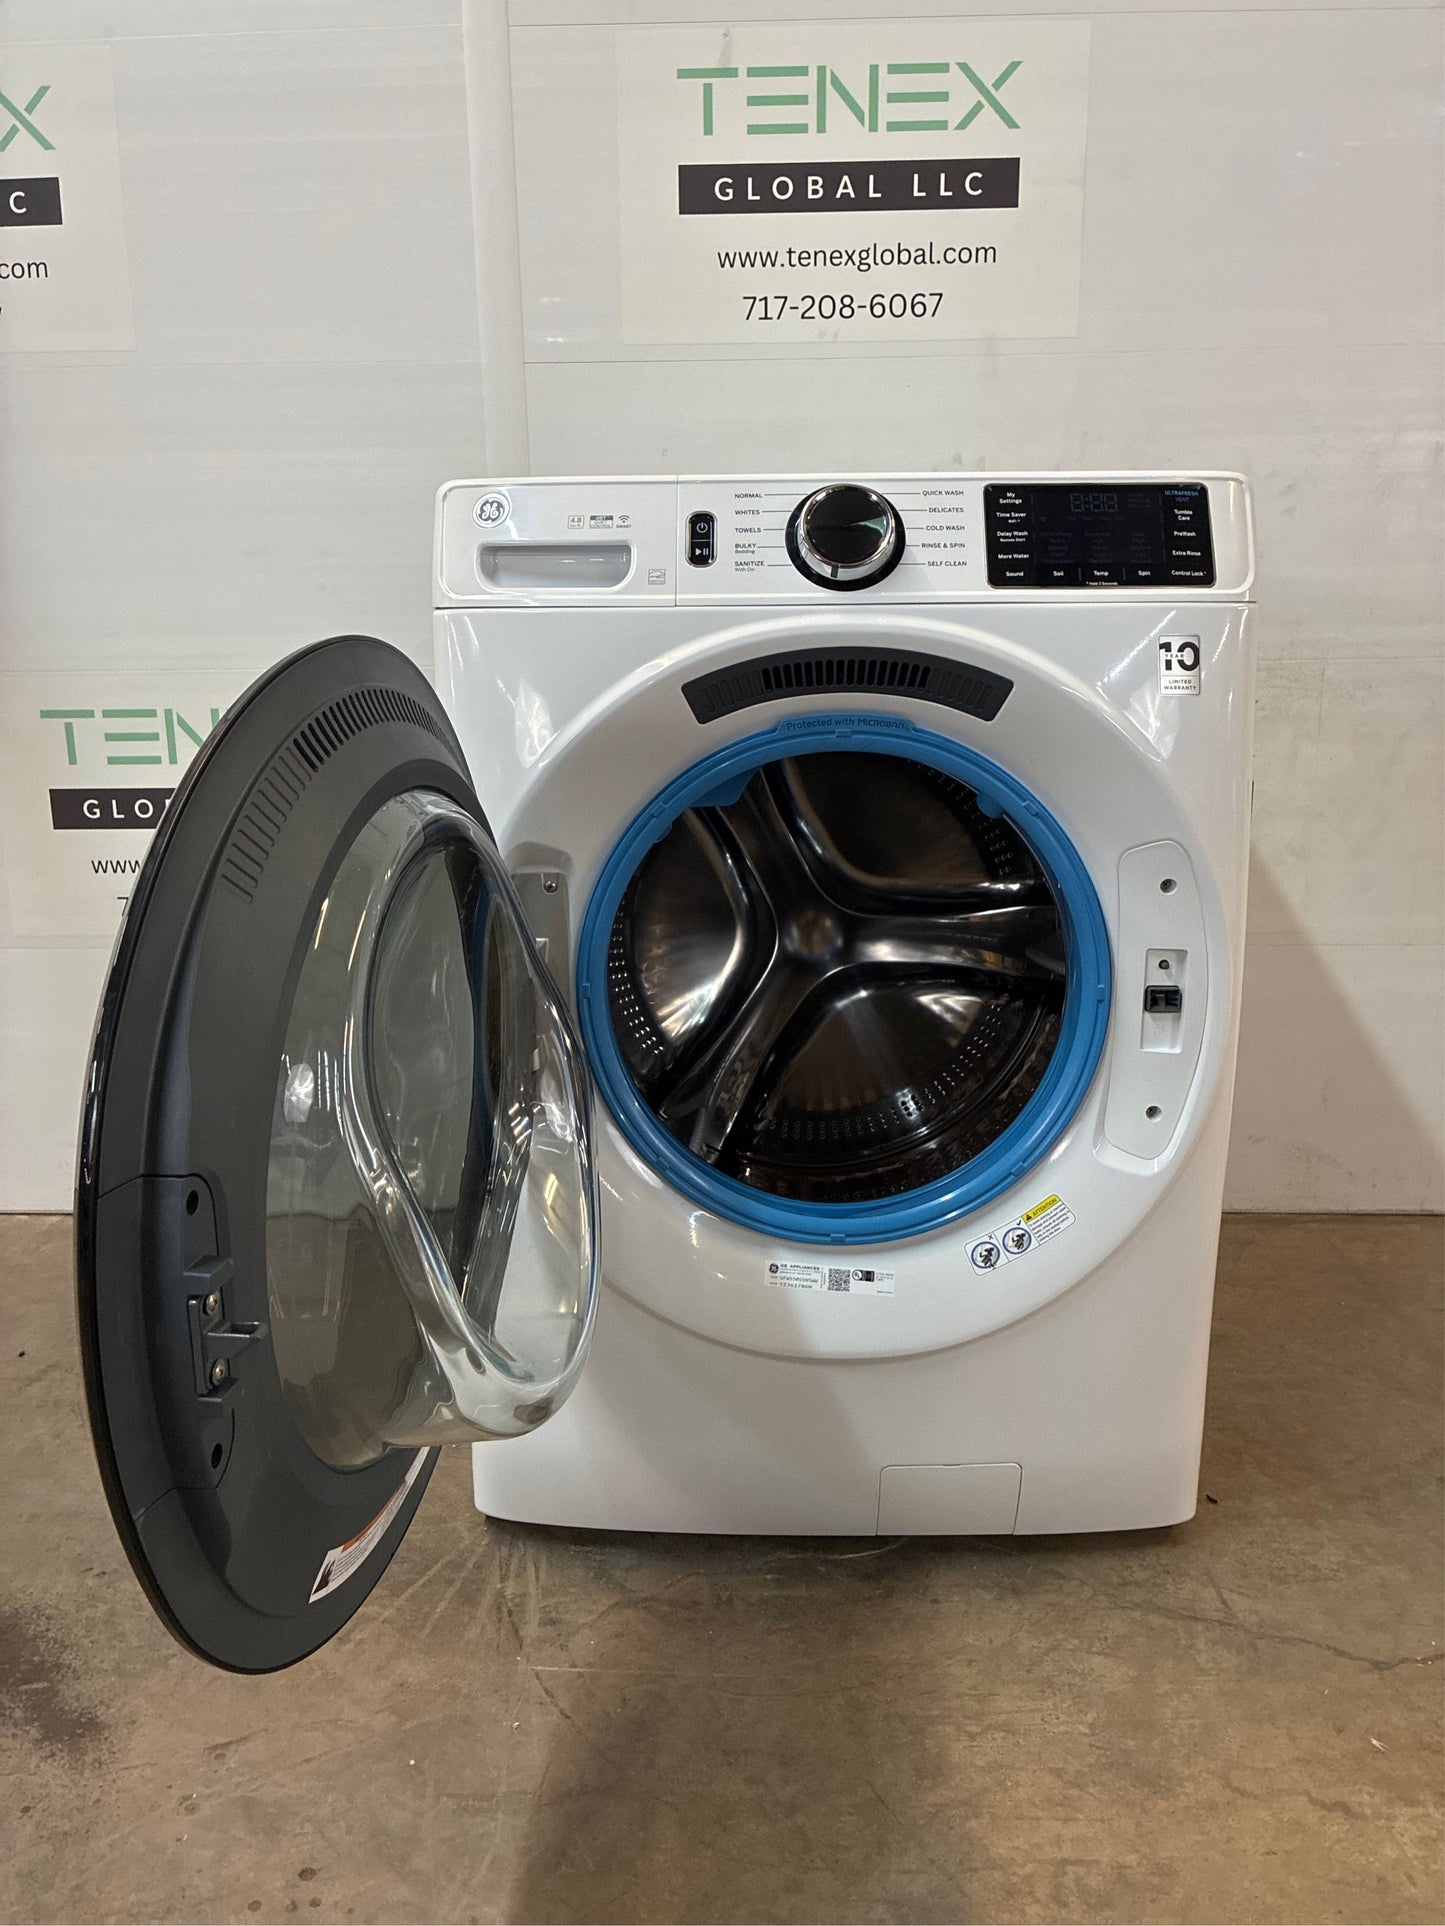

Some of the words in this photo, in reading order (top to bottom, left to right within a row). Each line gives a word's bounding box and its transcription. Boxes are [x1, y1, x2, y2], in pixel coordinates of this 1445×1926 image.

[676, 60, 1023, 136] TENEX
[714, 174, 882, 202] GLOBAL
[912, 171, 985, 197] LLC
[717, 242, 998, 273] www.tenexglobal.com
[742, 292, 944, 321] 717-208-6067
[1159, 641, 1200, 672] 10
[786, 718, 832, 731] Protected
[834, 717, 855, 727] with
[83, 799, 170, 819] GLO
[1032, 1197, 1057, 1217] ATTENTION
